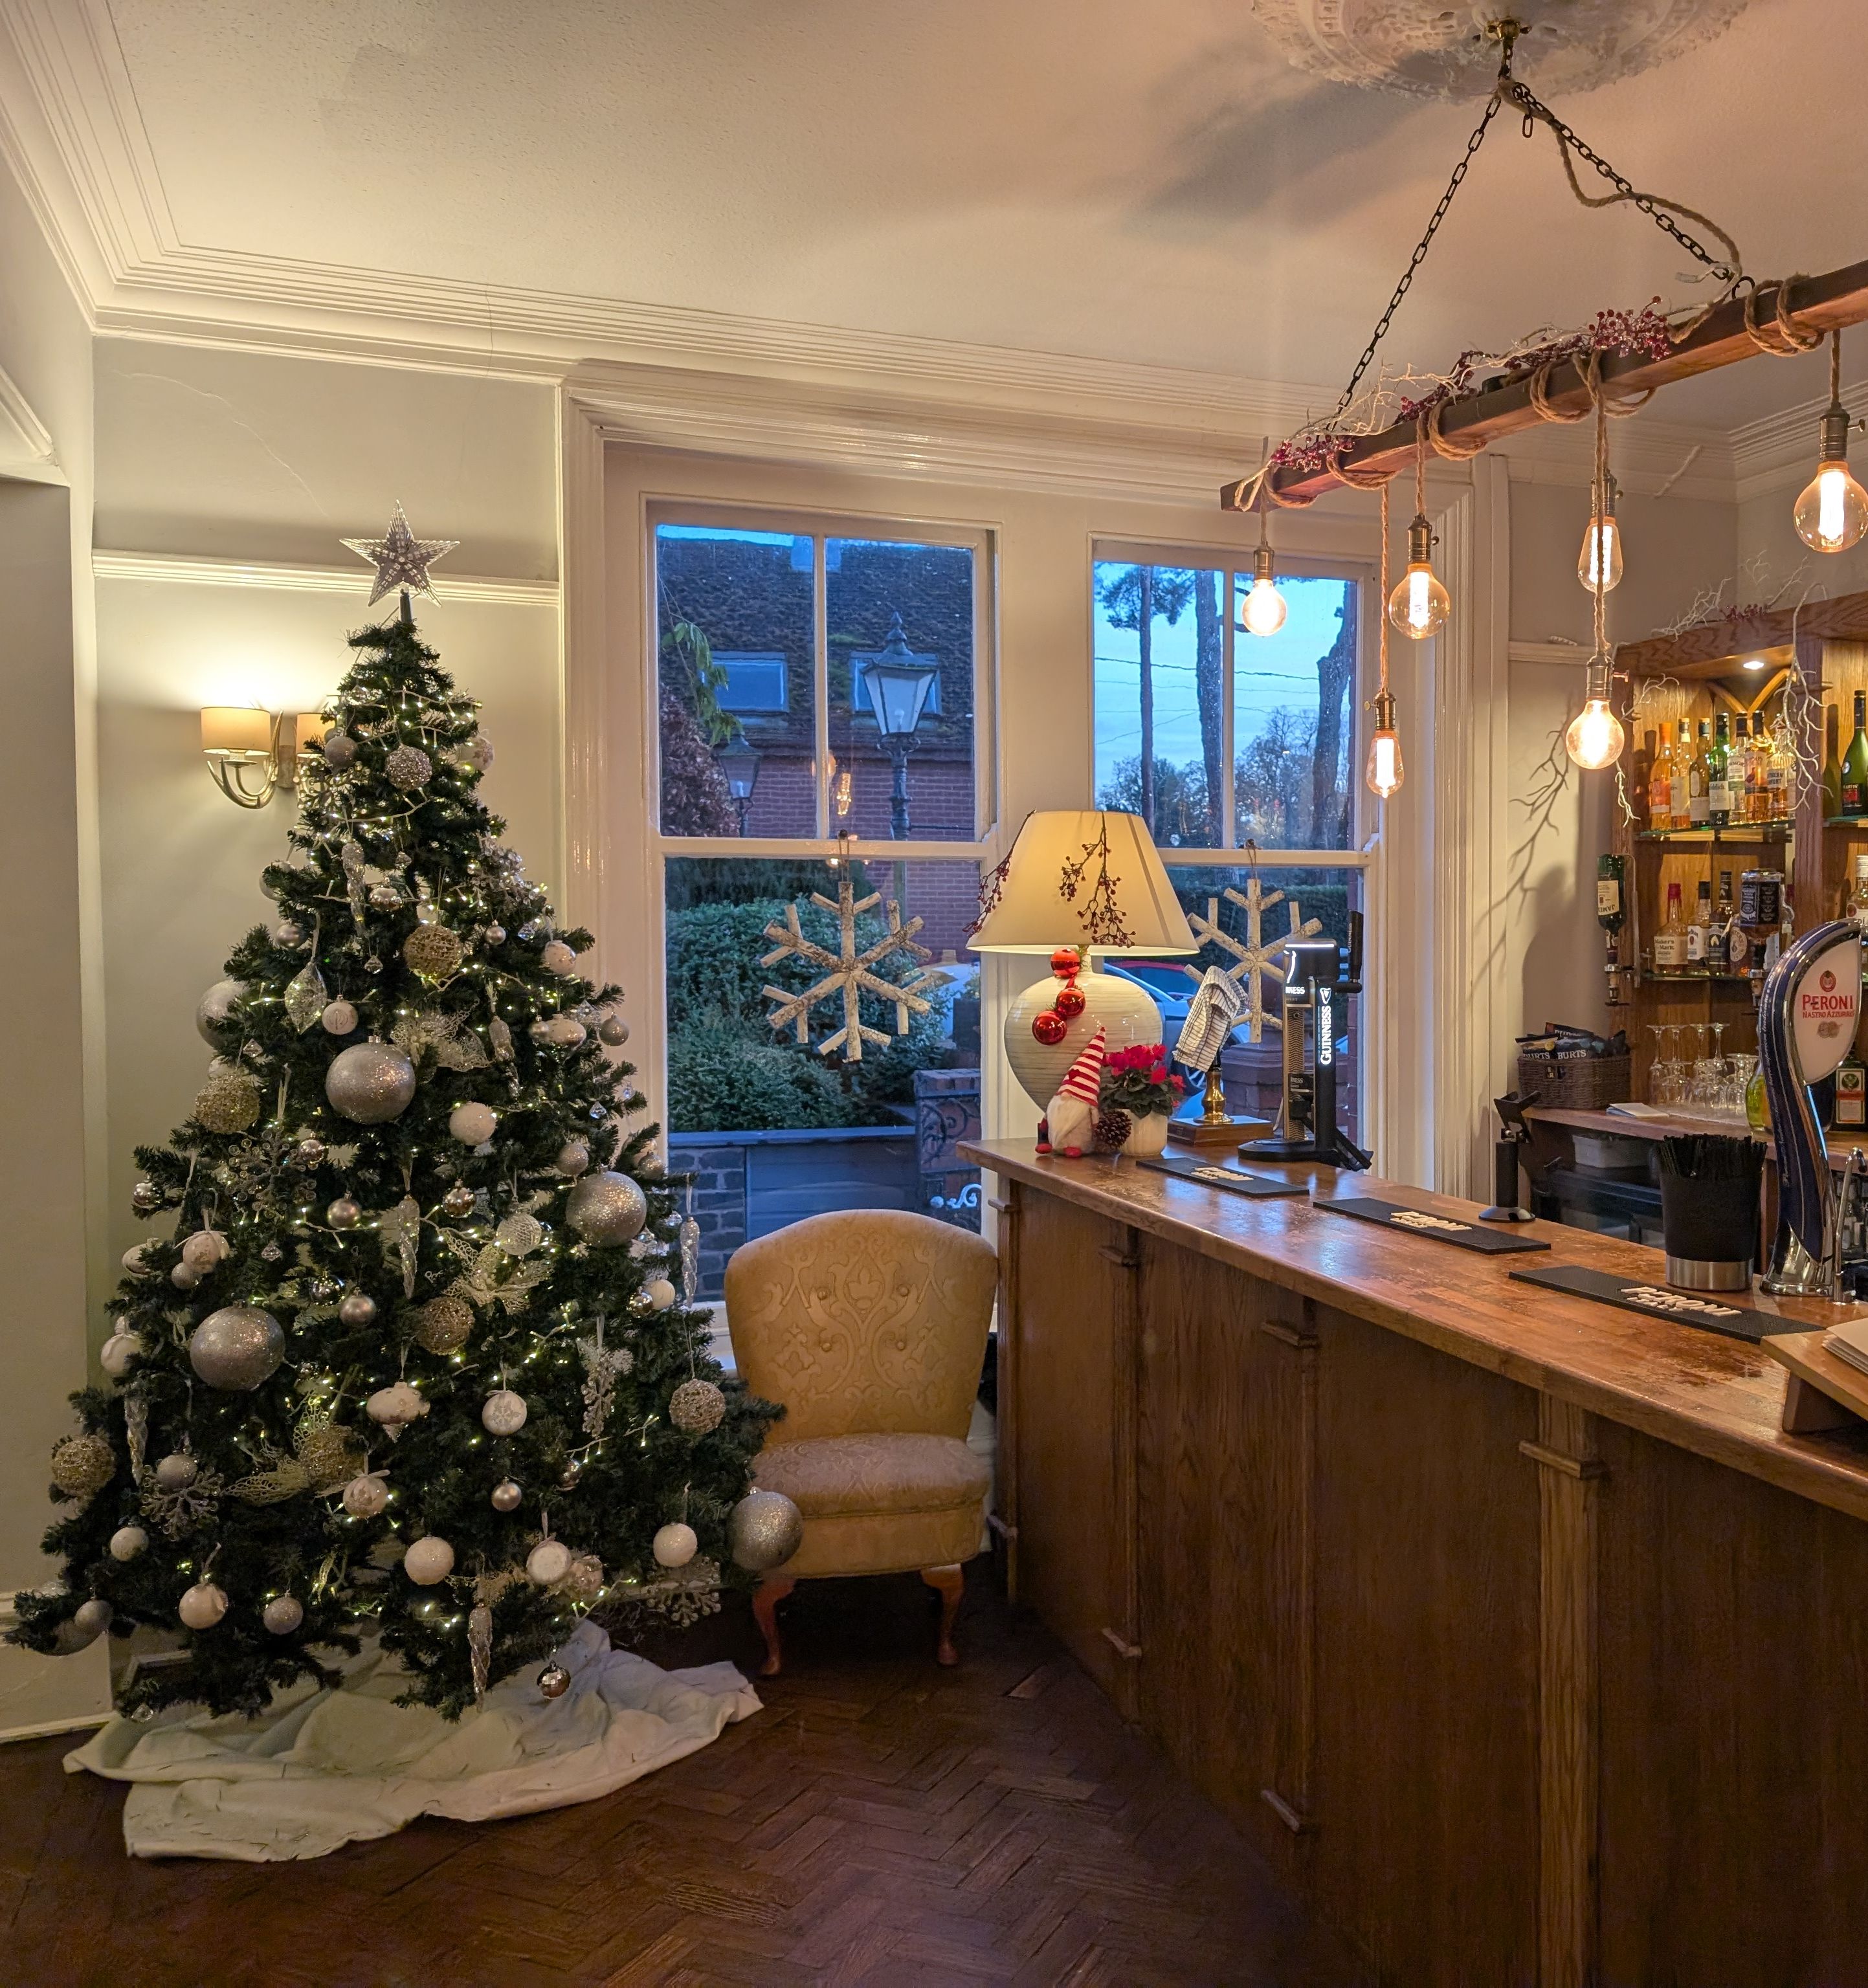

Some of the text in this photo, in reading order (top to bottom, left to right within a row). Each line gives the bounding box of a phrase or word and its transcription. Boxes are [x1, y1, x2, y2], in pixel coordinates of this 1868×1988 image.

[1802, 994, 1854, 1010] PERONI
[1320, 1005, 1332, 1065] GUINNESS
[1557, 1050, 1586, 1060] BURTS
[1620, 1286, 1742, 1318] PERONI
